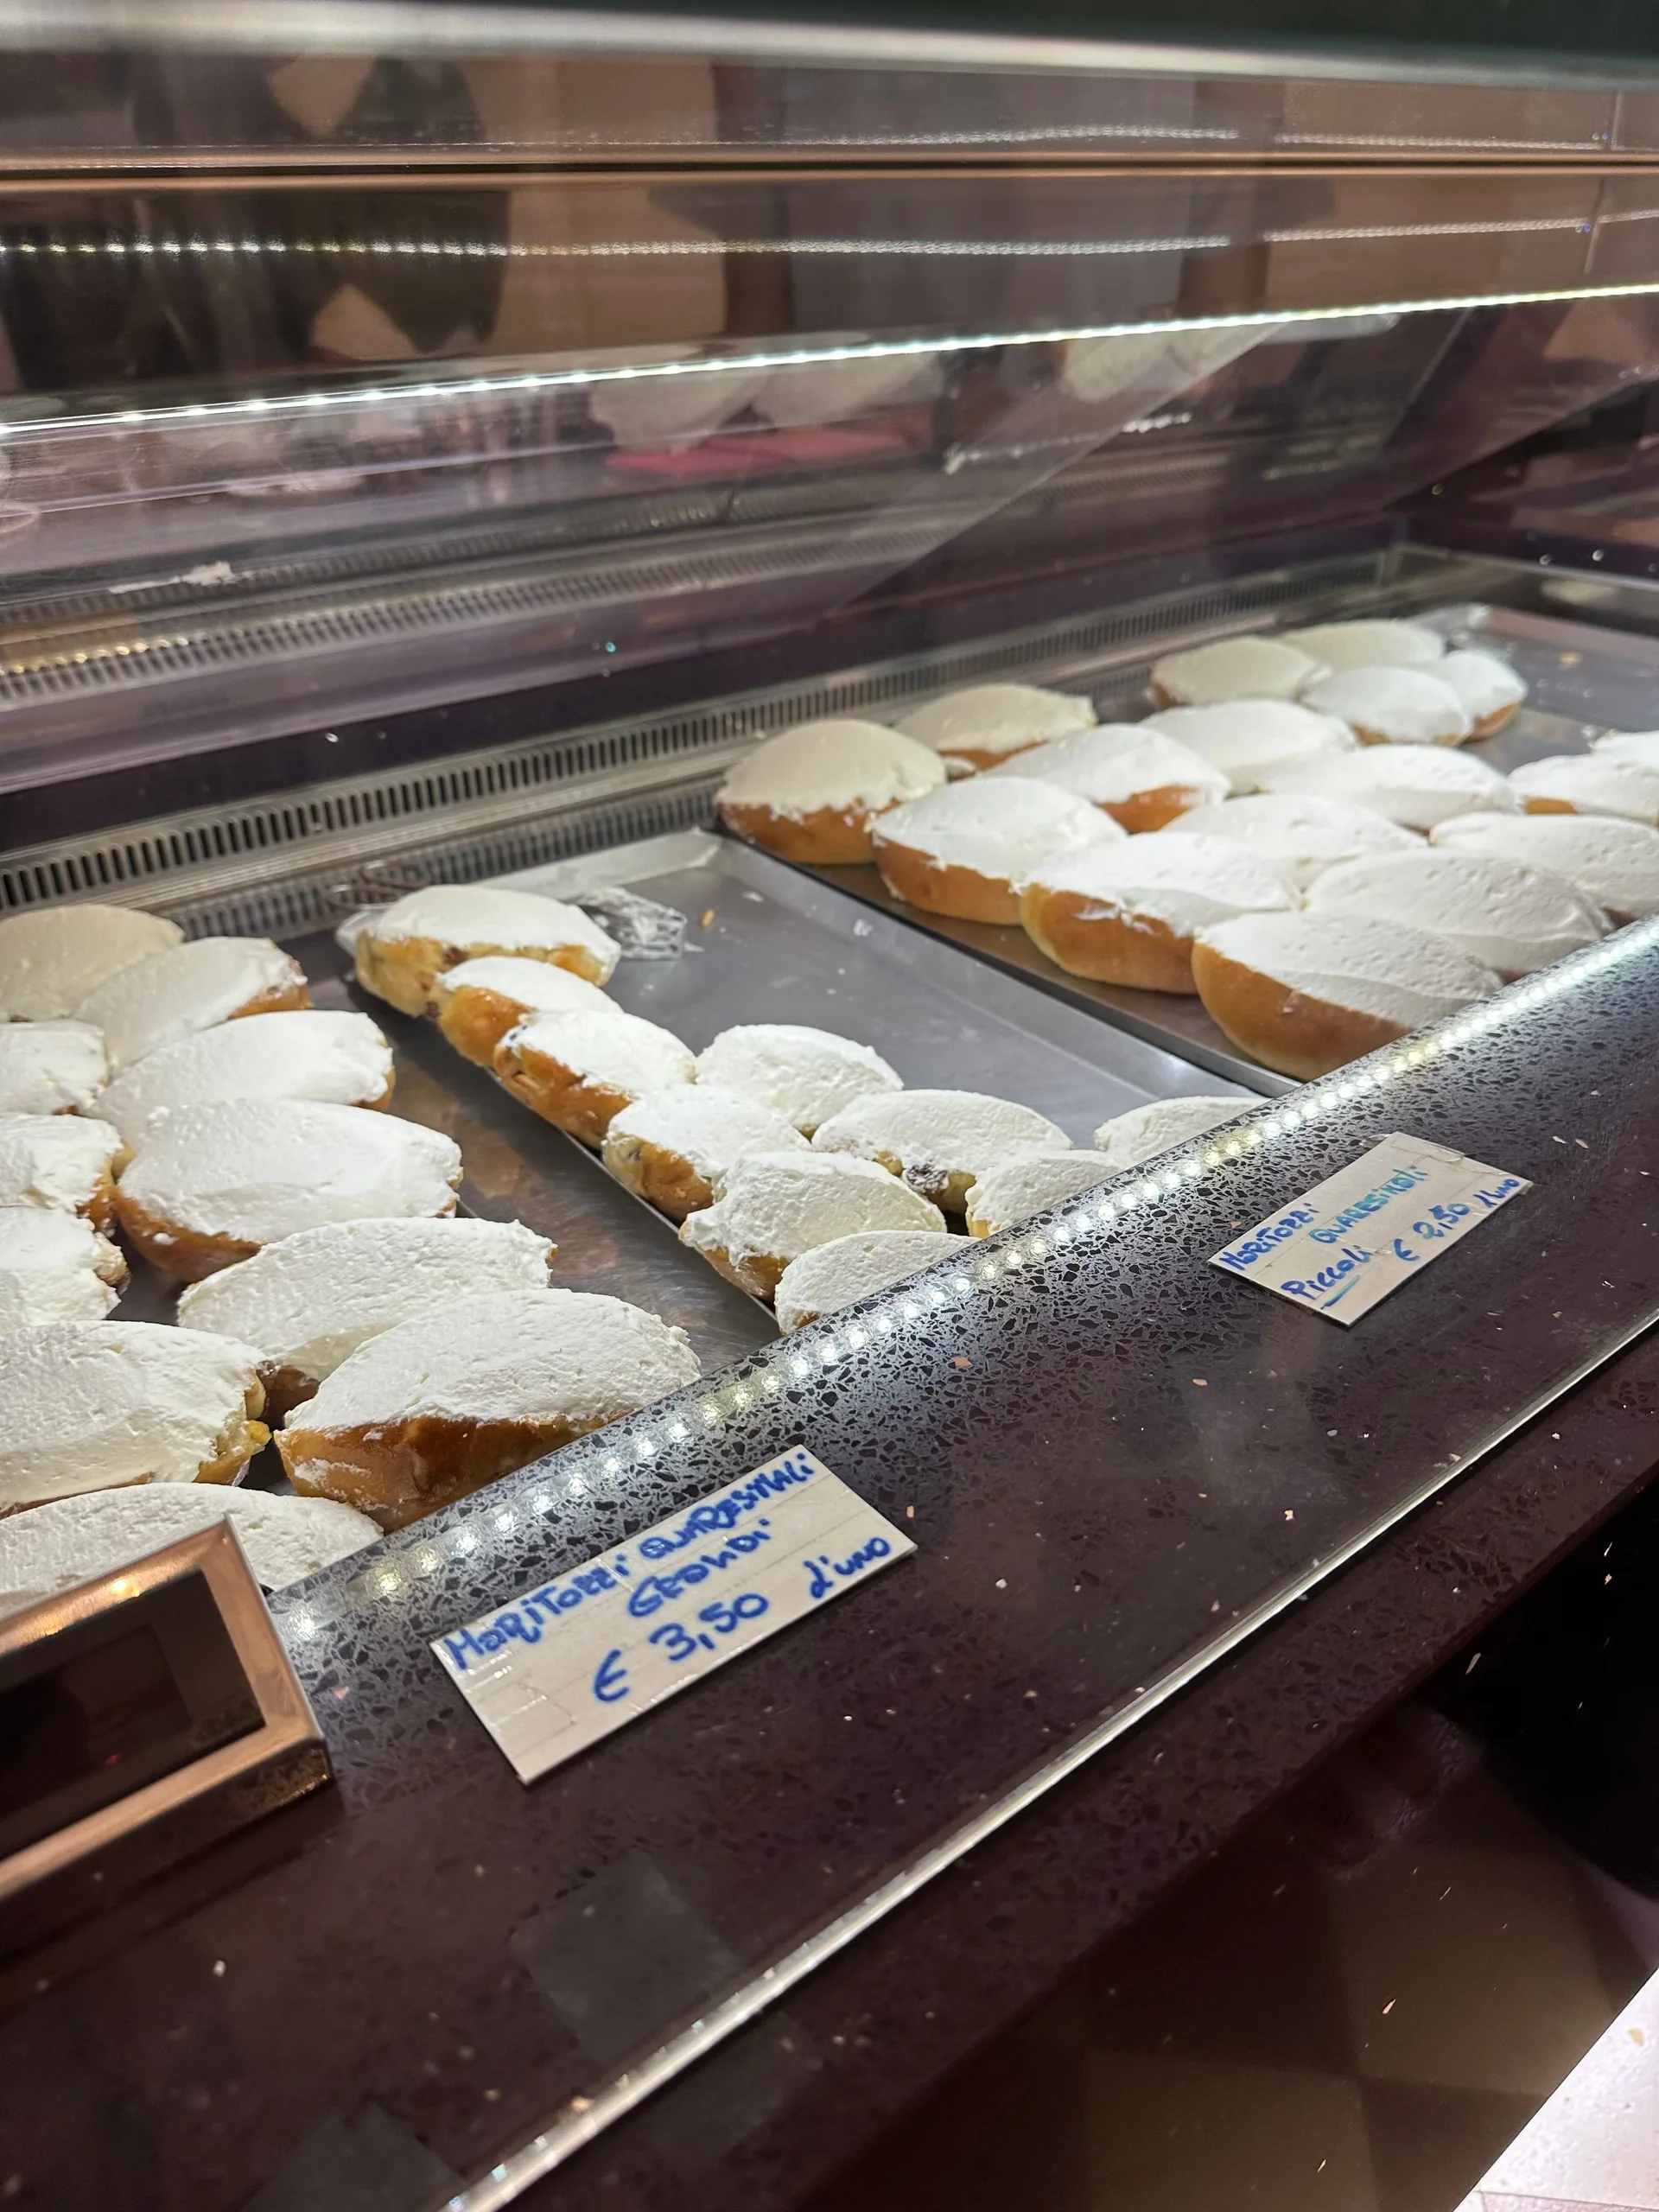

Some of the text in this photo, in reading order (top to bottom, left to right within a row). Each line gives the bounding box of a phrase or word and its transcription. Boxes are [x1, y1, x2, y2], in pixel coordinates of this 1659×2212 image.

[1394, 1238, 1420, 1262] €
[1413, 1203, 1470, 1240] 2,50
[1281, 1245, 1374, 1300] Piccoli
[593, 1649, 630, 1702] €
[650, 1592, 768, 1662] 3,50
